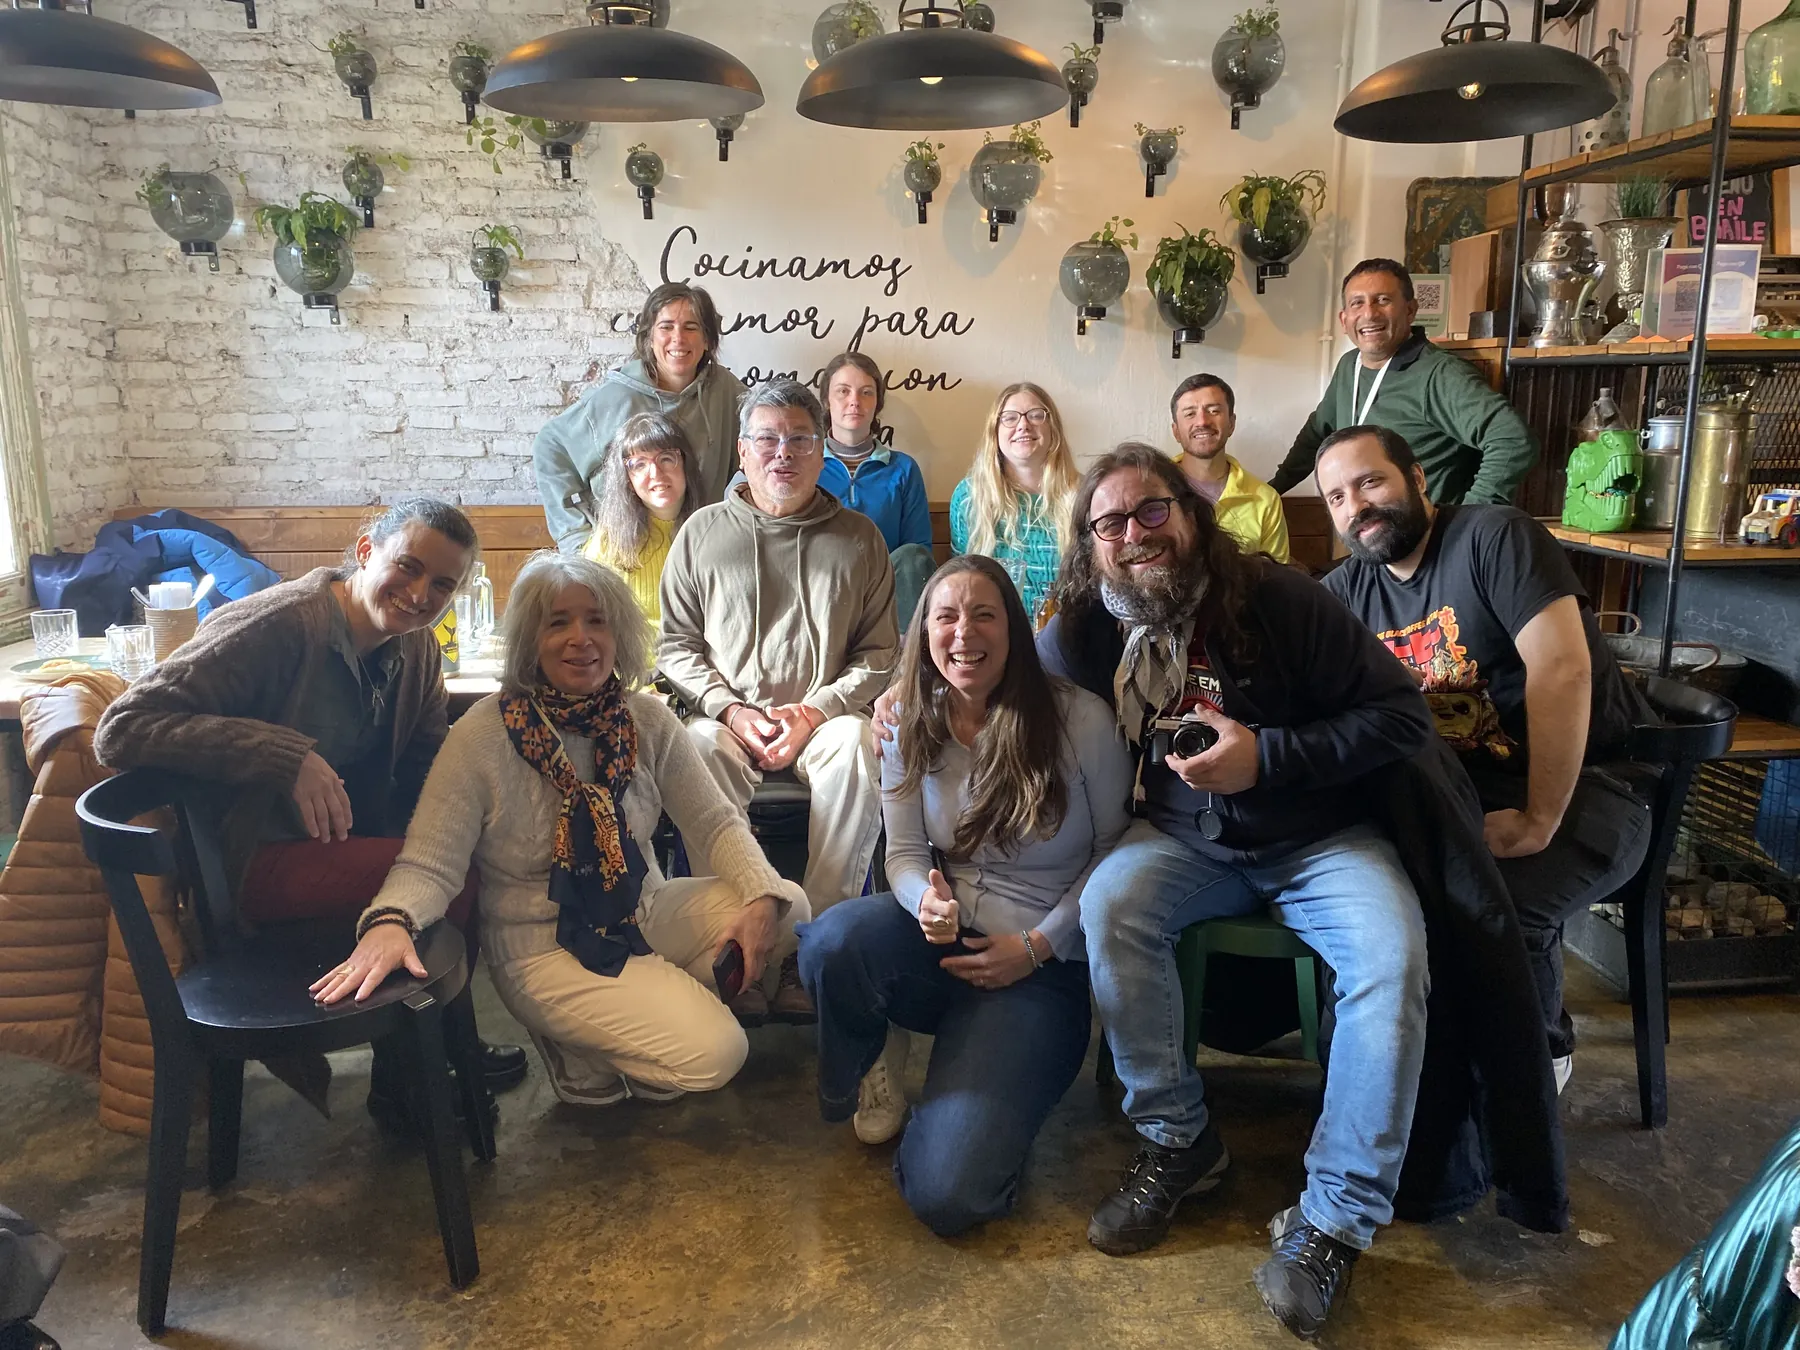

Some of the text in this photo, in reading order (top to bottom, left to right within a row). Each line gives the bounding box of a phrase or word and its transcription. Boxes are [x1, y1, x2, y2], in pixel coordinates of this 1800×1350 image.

[660, 225, 912, 297] Cocinamos
[847, 306, 974, 353] para
[883, 369, 962, 391] con
